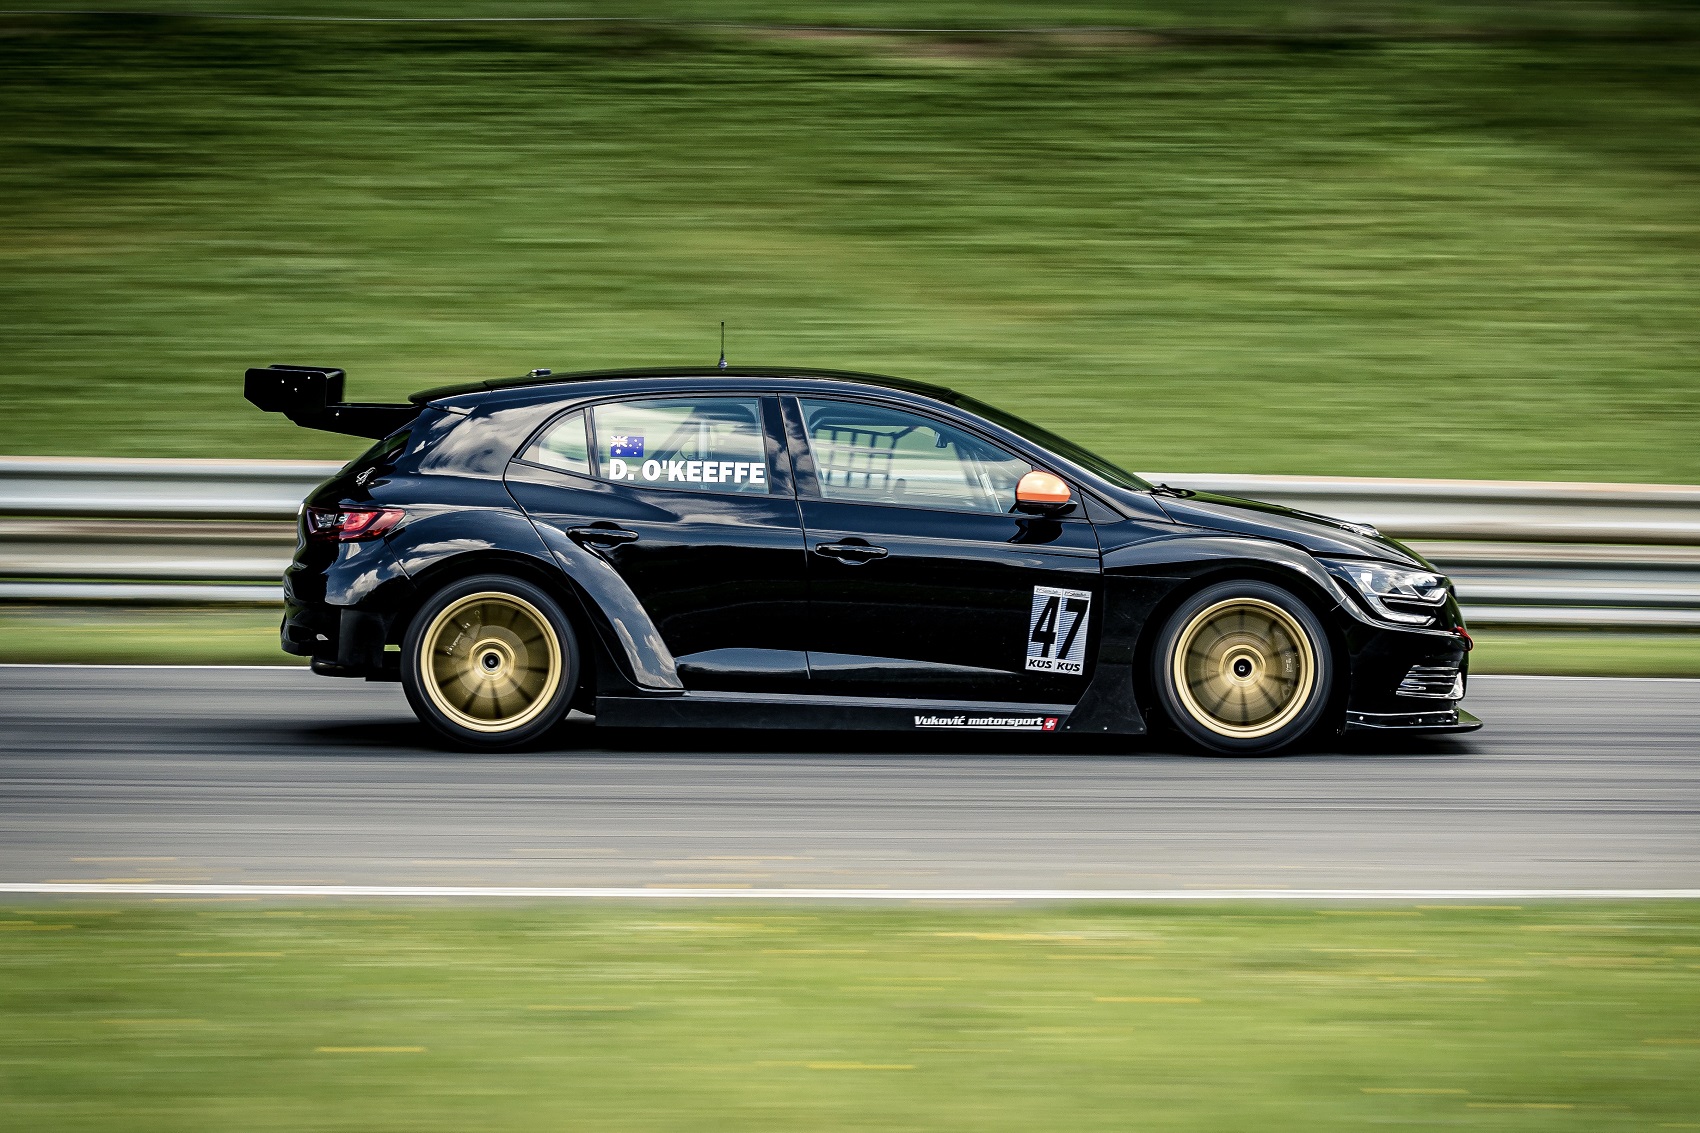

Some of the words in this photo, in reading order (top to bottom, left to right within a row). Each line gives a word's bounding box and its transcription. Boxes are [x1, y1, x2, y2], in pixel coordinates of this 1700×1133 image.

[609, 458, 635, 481] D.
[642, 459, 766, 484] O'KEEFFE
[1030, 596, 1089, 660] 47
[914, 715, 966, 725] Vuković
[967, 717, 1043, 727] motorsport
